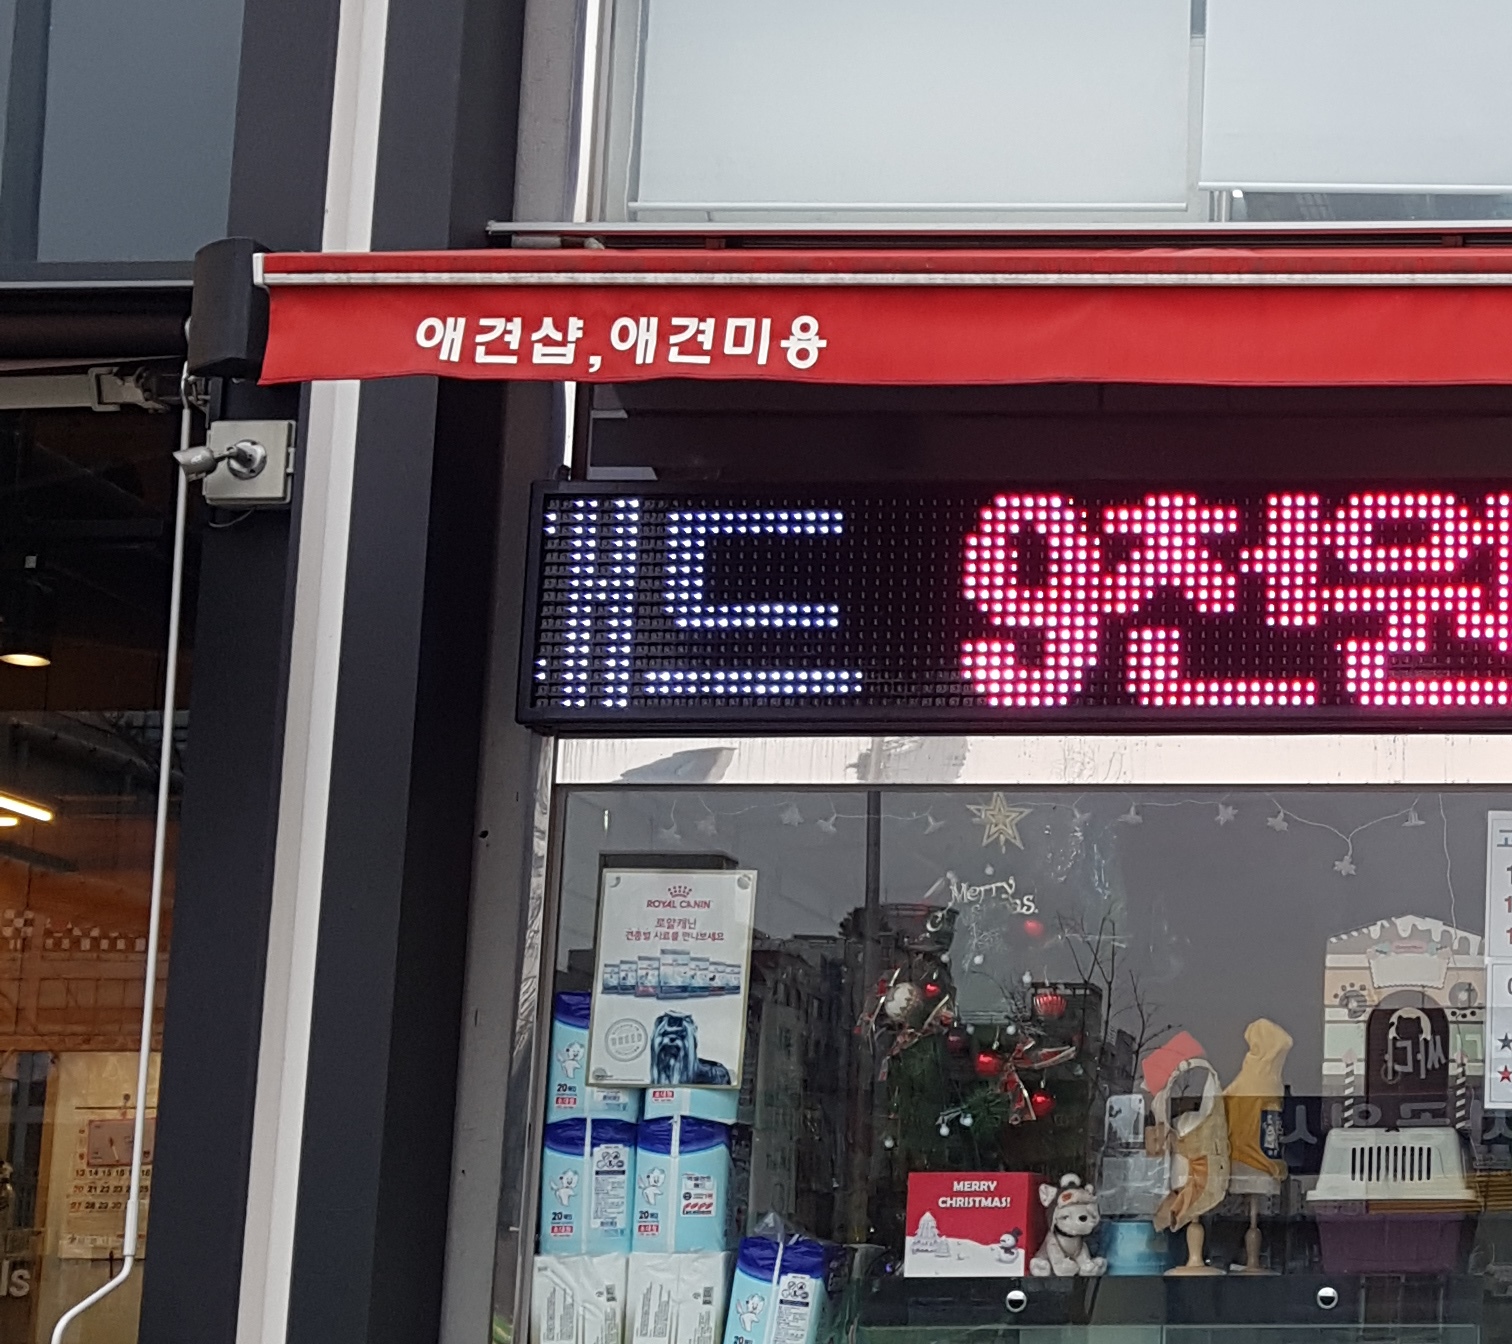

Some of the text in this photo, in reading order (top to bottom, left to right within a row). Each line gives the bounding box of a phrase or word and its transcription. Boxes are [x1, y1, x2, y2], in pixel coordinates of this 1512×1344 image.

[646, 900, 711, 908] ROYAL CANIN
[953, 1181, 997, 1192] MERRY
[938, 1197, 1011, 1208] CHRISTMAS!
